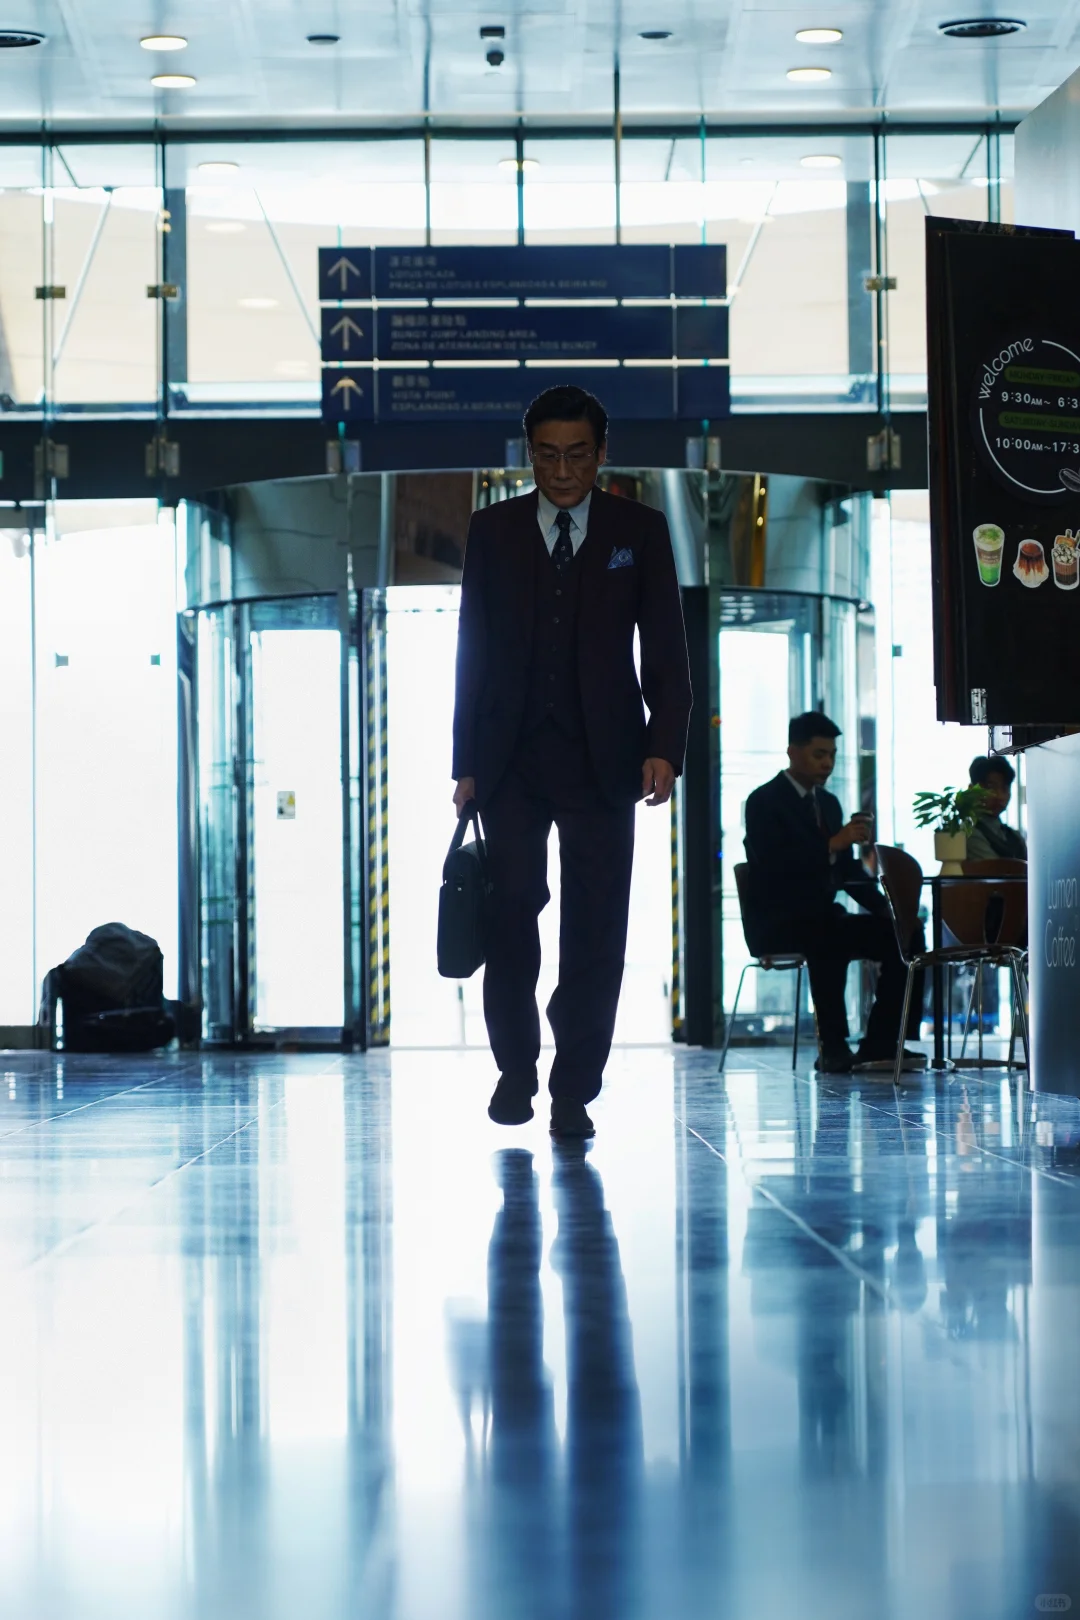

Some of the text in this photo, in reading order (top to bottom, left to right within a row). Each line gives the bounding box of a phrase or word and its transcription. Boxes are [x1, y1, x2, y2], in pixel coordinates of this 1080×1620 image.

[430, 330, 458, 339] JUMP
[460, 330, 506, 339] LANDING
[508, 330, 538, 338] AREA
[979, 339, 1034, 398] welcome
[1057, 396, 1080, 409] 6:3
[1047, 864, 1078, 910] Lumen
[1045, 919, 1076, 968] Coffee
